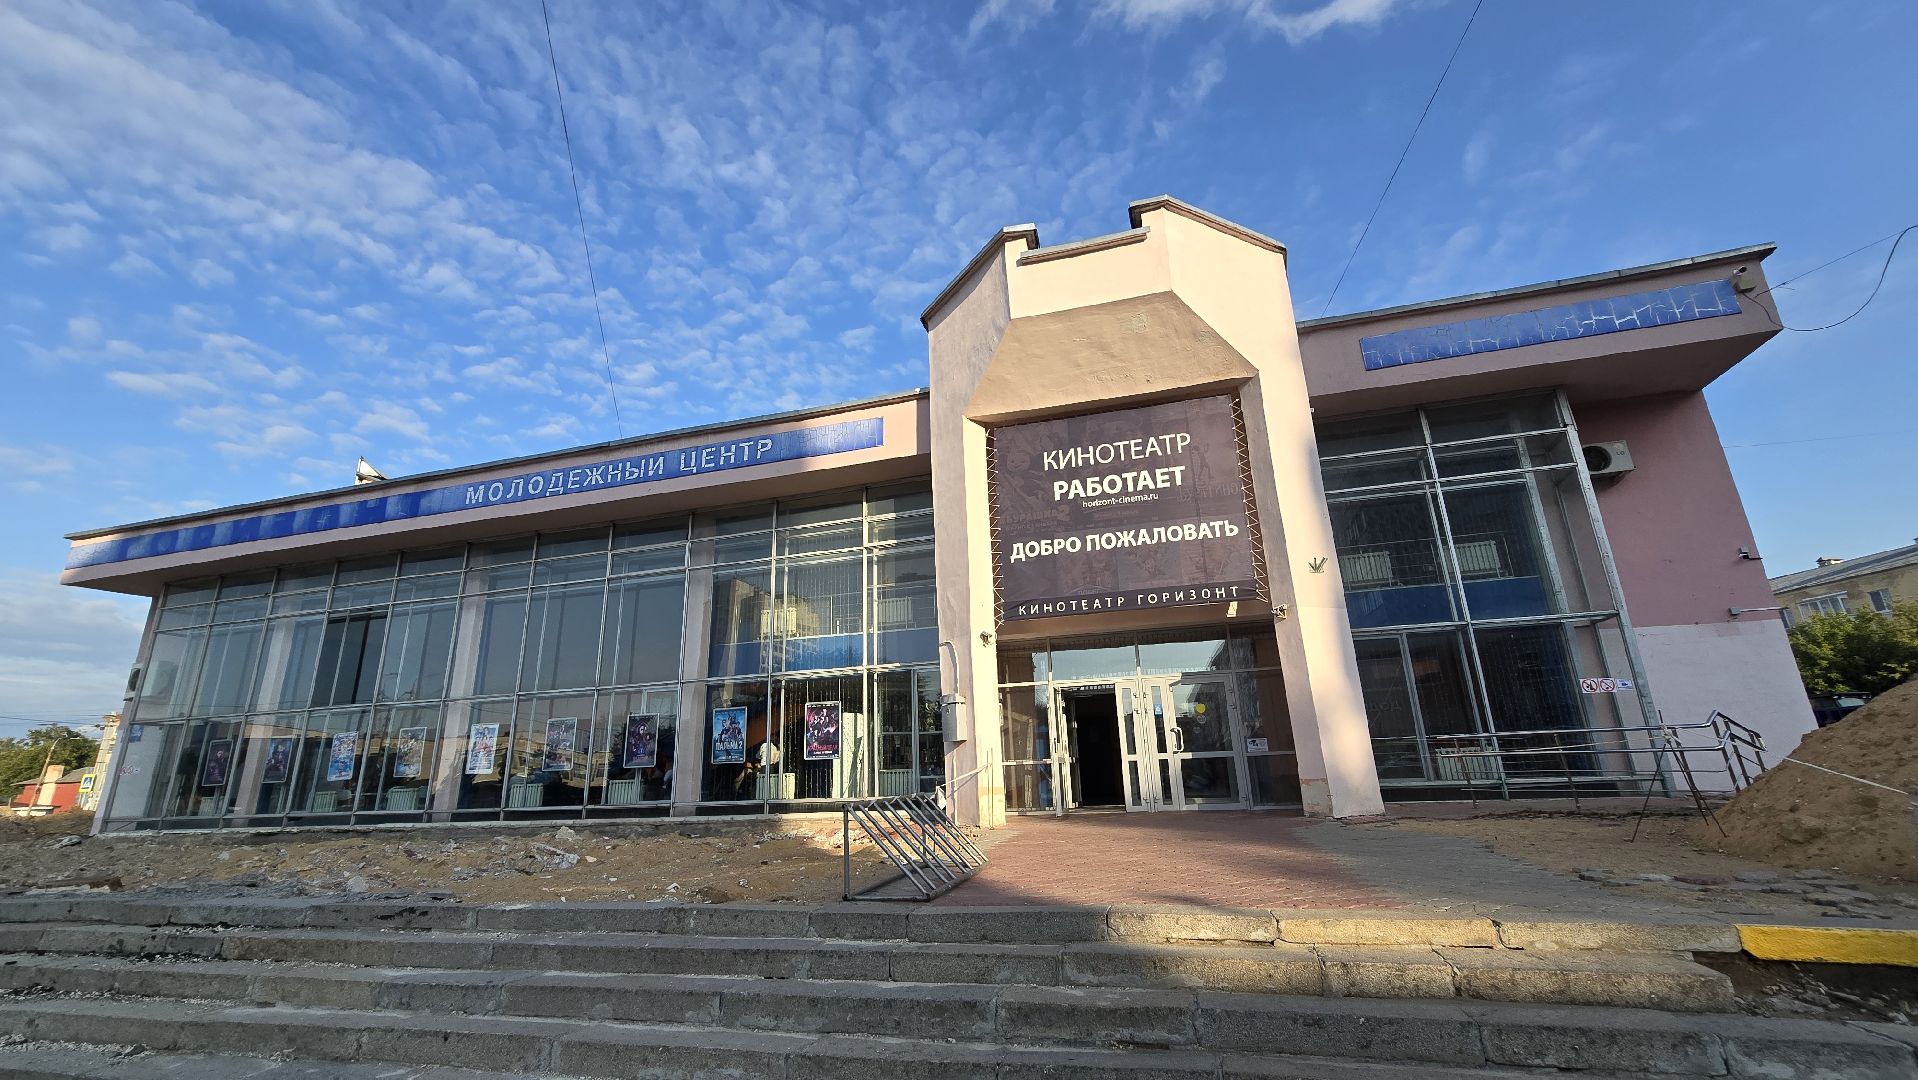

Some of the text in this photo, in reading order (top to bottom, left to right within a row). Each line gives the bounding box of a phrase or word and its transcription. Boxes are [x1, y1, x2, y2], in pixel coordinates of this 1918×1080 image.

[679, 438, 773, 474] ЦЕНТР
[1043, 432, 1191, 472] КИНОТЕАТР
[1053, 465, 1186, 501] РАБОТАЕТ
[1082, 493, 1159, 508] horizont-cinema.ru
[1009, 519, 1240, 563] ДОБРО ПОЖАЛОВАТЬ
[1018, 585, 1239, 616] КИНОТЕАТР ГОРИЗОНТ
